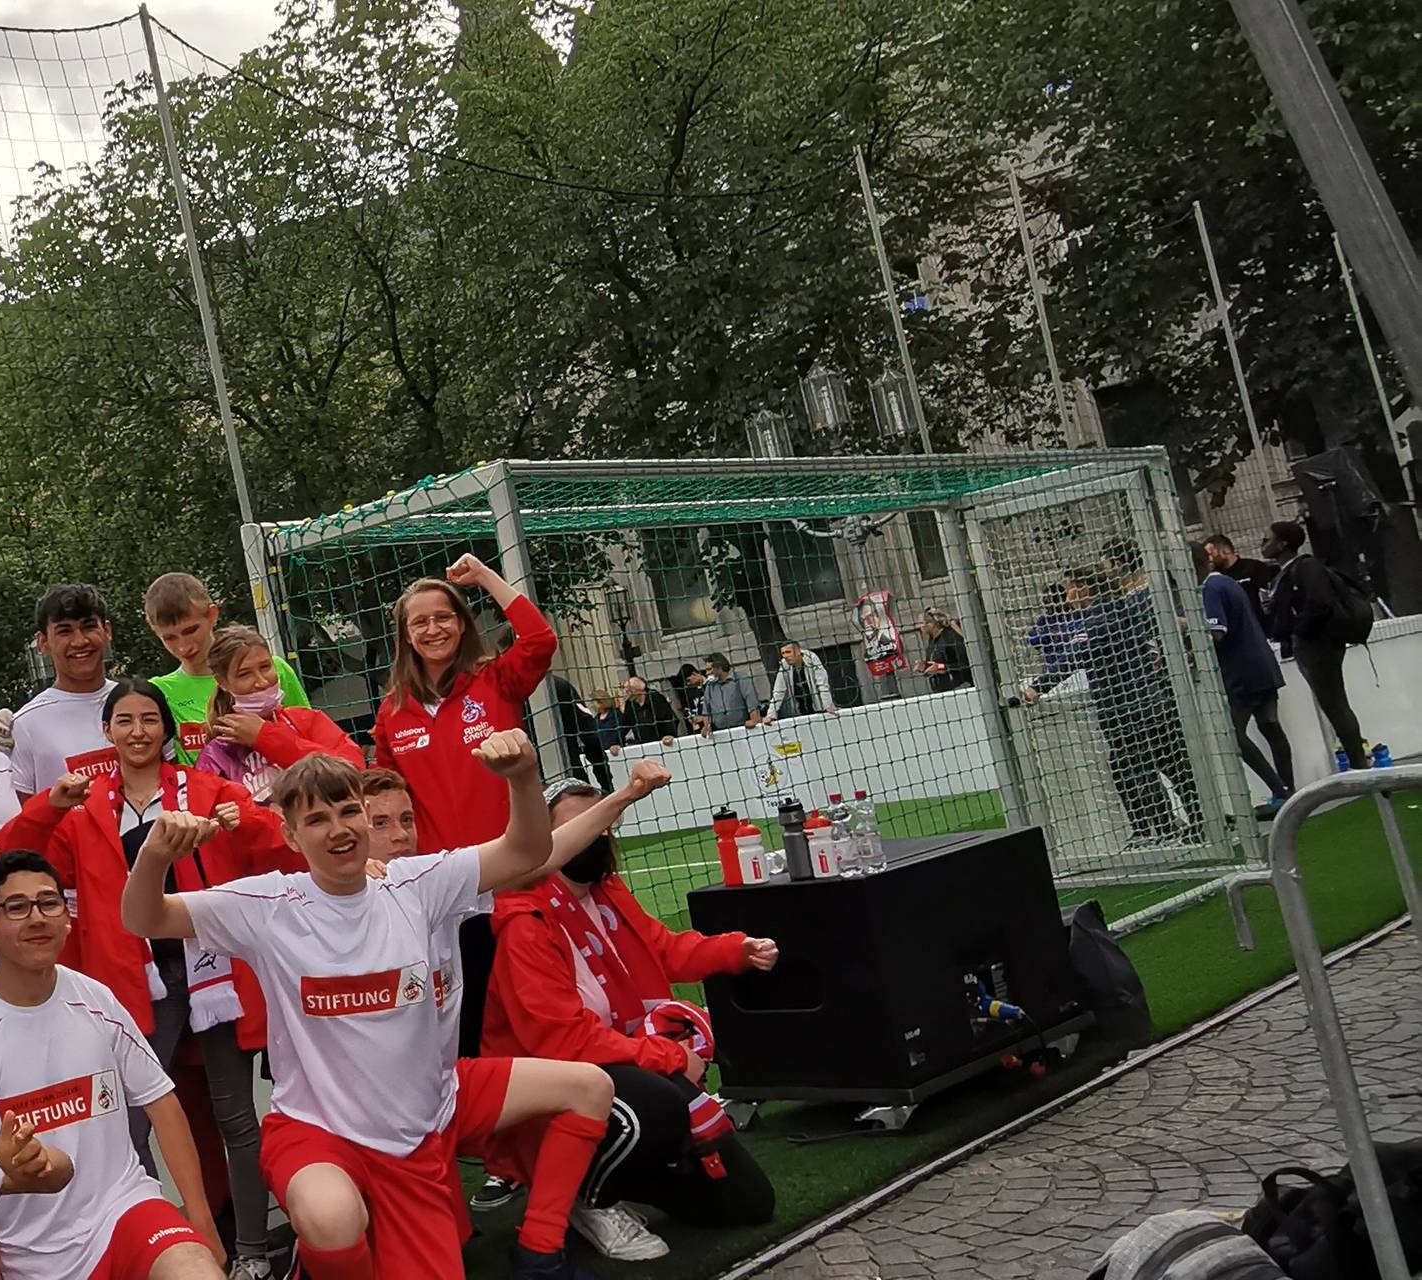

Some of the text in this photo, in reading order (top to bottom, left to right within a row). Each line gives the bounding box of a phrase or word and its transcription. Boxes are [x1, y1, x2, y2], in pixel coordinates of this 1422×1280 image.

[394, 726, 427, 739] uhlsport
[462, 726, 496, 745] Energie
[463, 721, 490, 736] Rhein
[306, 989, 391, 1010] STIFTUNG
[13, 1097, 87, 1131] TIFTUNG
[147, 1226, 195, 1244] uhlsport
